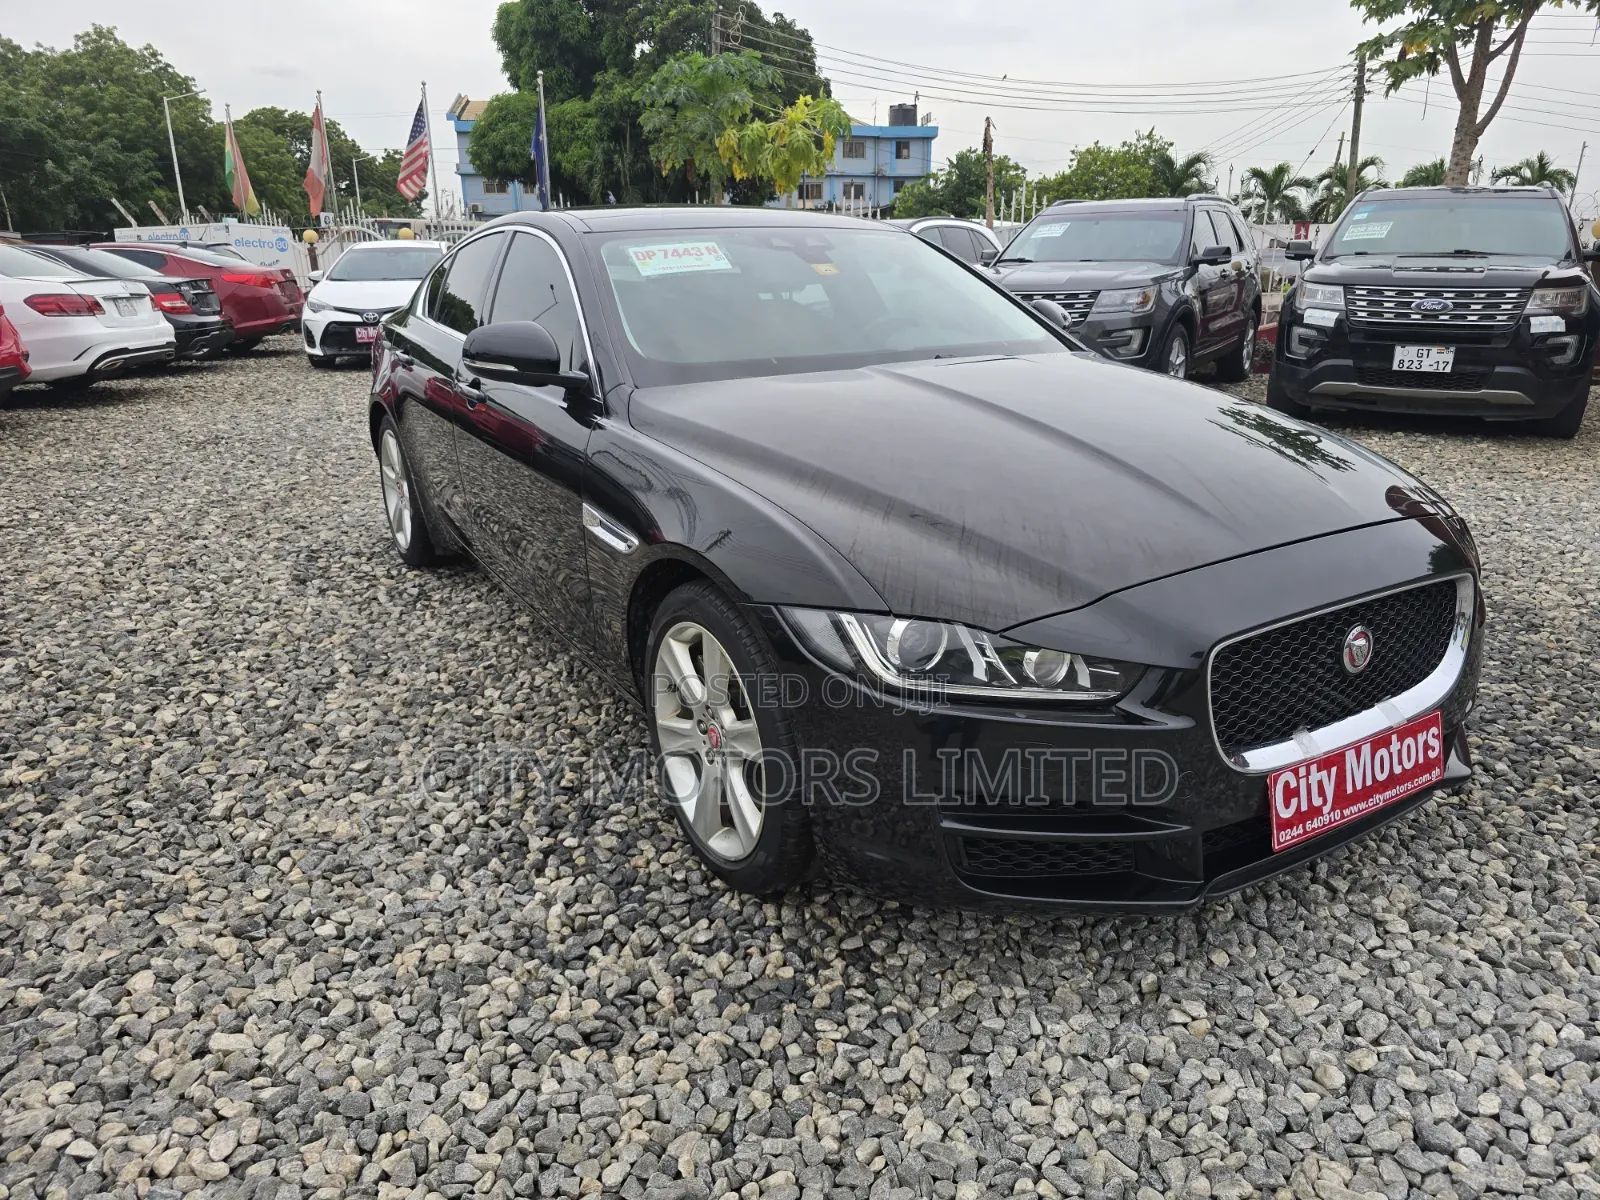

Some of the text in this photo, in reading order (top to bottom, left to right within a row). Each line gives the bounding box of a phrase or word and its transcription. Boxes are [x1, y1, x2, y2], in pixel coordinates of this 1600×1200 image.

[234, 237, 274, 249] electro
[632, 245, 720, 261] DP 7443 N
[1420, 301, 1444, 310] Ford
[1416, 348, 1433, 359] GT
[1397, 359, 1423, 370] 823
[1275, 726, 1440, 819] City Motors
[1279, 767, 1441, 843] 0244 640910 www.citymotors.com.gh
